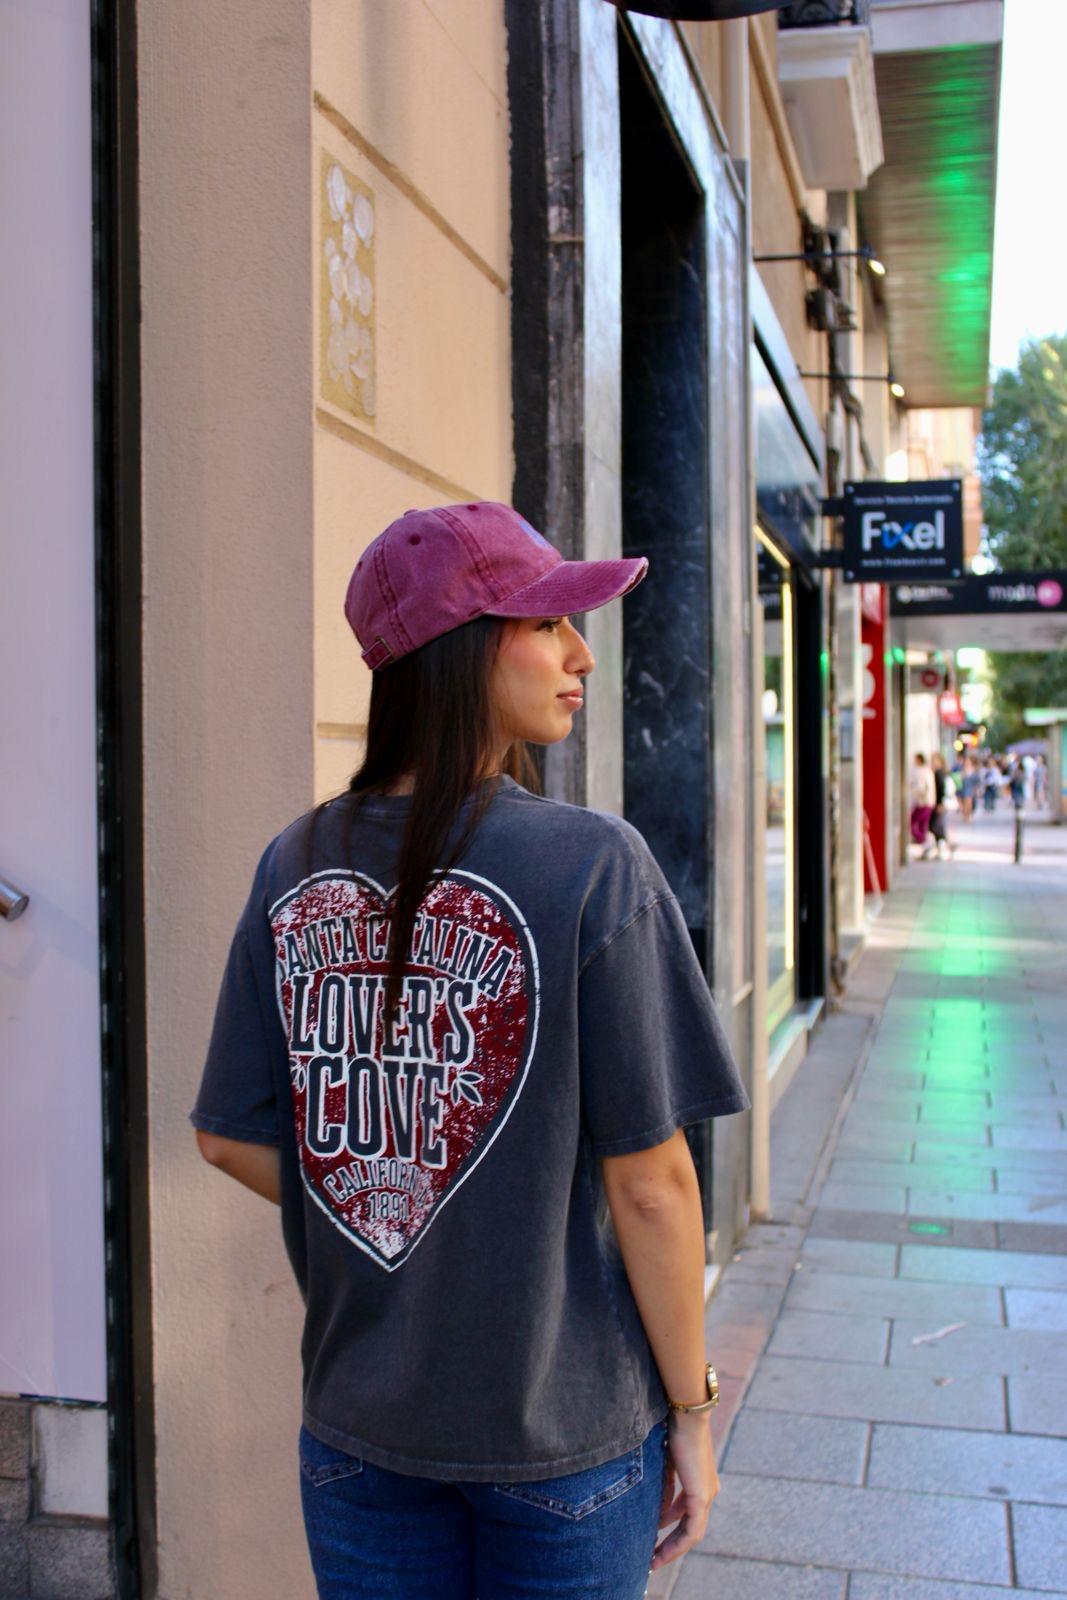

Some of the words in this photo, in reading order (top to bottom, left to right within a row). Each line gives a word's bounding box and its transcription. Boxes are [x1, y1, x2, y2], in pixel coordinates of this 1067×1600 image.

[275, 915, 362, 986] ANTA
[366, 911, 516, 1000] CALINA
[289, 972, 478, 1067] LOVER'S
[305, 1054, 450, 1170] COVE
[367, 1191, 409, 1222] 1891
